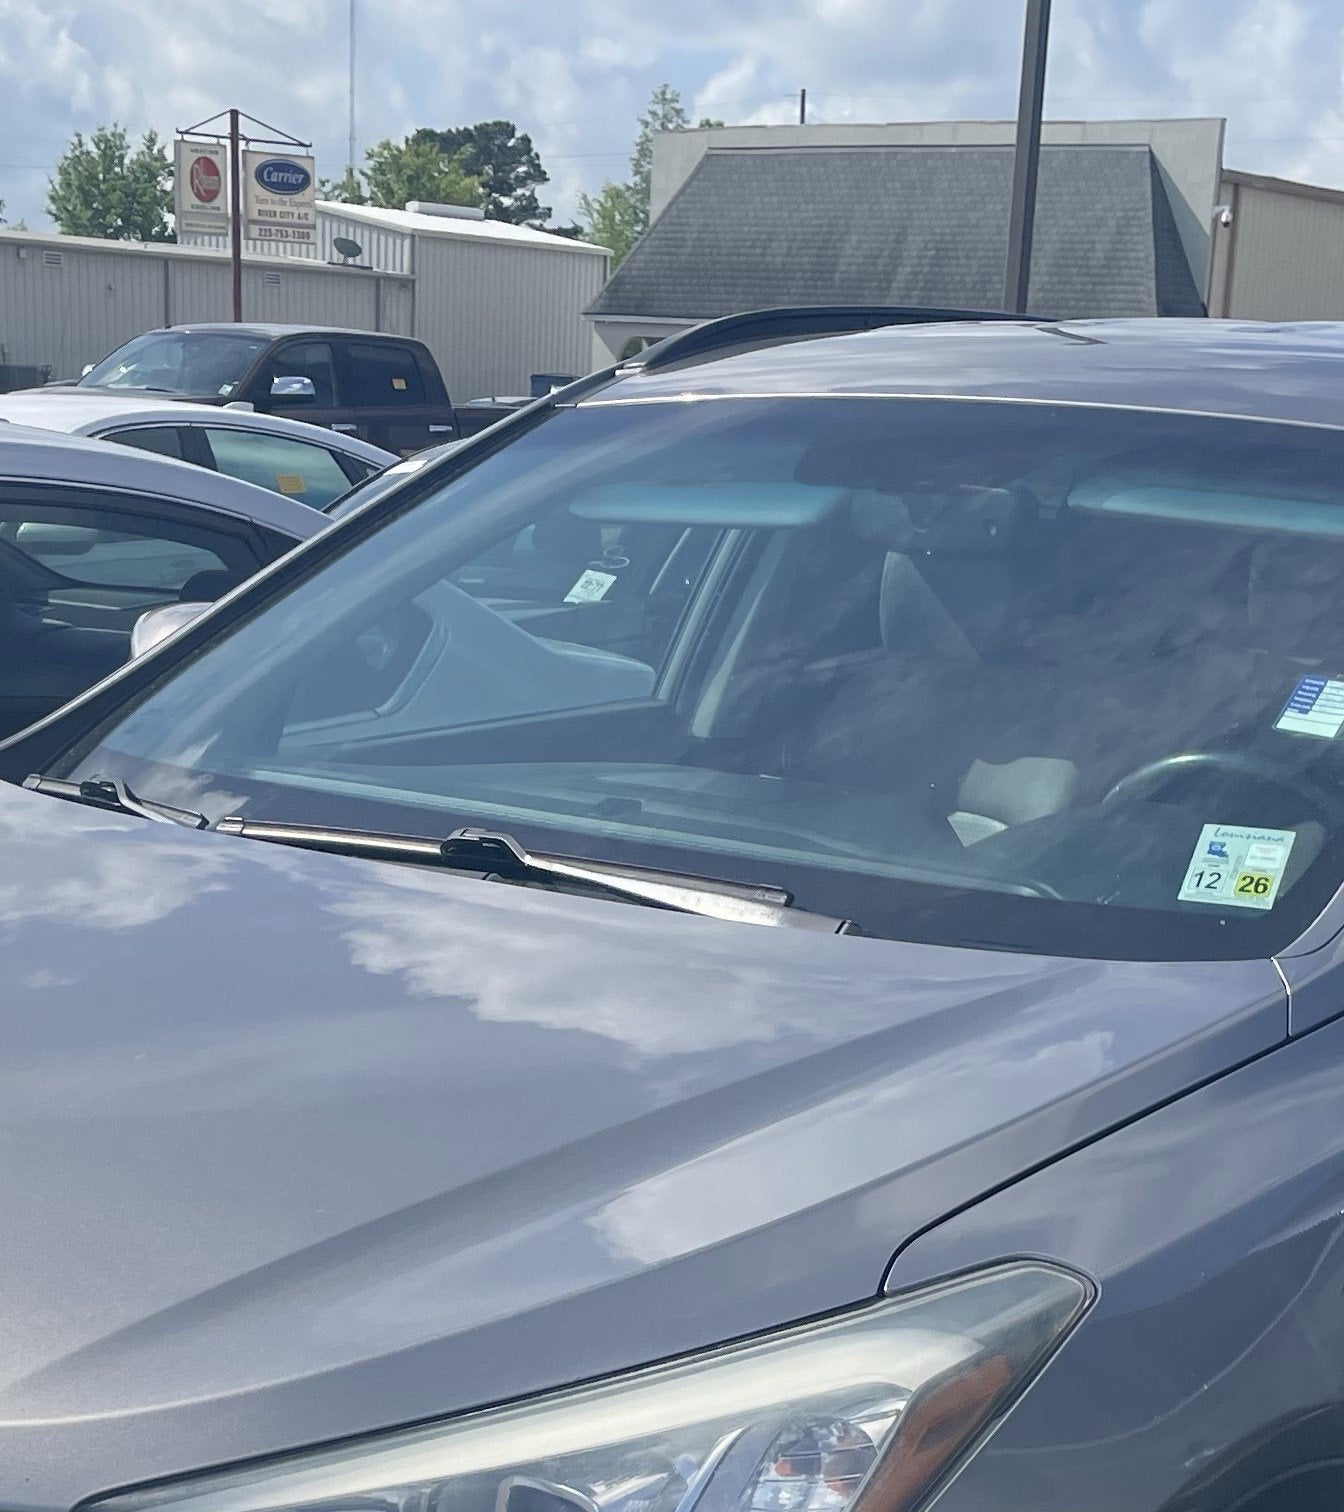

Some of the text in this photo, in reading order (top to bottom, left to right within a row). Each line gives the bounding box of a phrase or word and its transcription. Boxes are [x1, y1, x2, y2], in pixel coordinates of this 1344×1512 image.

[263, 166, 305, 185] Carrier
[279, 210, 295, 219] CITY
[1213, 827, 1285, 843] Louisiana
[1194, 870, 1270, 895] 12 26
